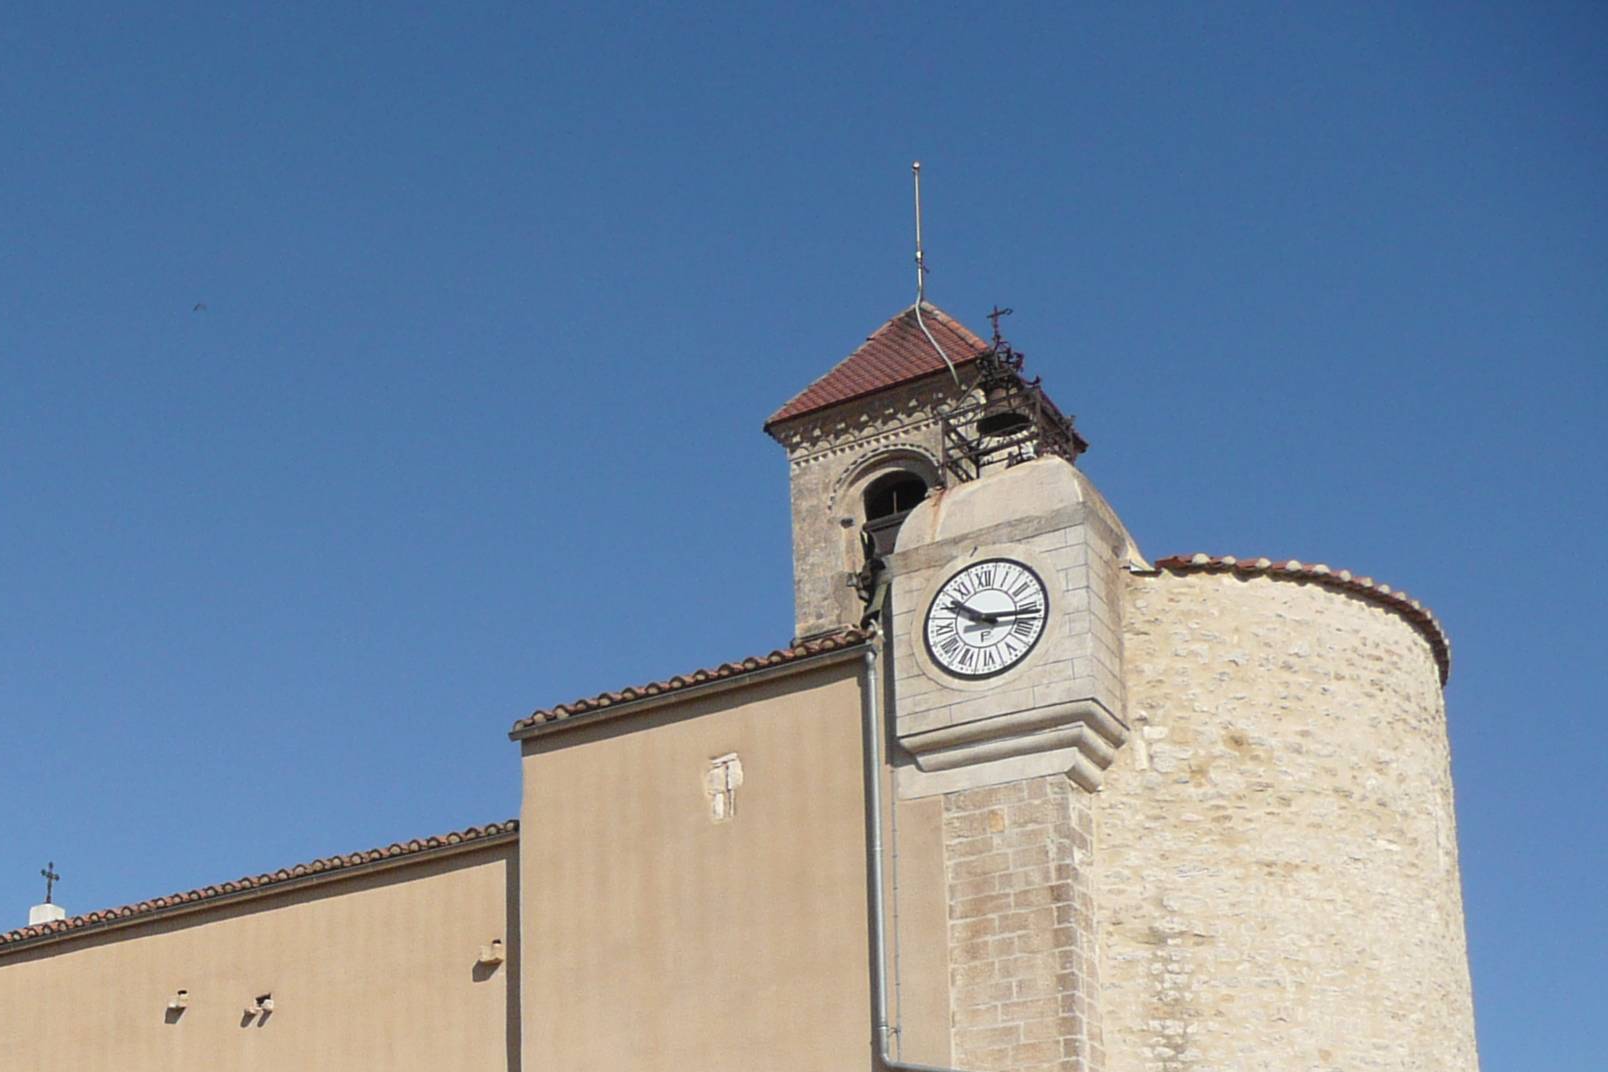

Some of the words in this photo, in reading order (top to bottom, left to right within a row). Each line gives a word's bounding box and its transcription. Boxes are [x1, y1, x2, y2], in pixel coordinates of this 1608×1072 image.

[975, 570, 992, 588] XII
[999, 571, 1009, 588] I
[953, 582, 971, 600] XI
[1012, 582, 1030, 597] II
[935, 622, 954, 636] IX
[1004, 641, 1018, 656] V
[983, 650, 996, 667] VI
